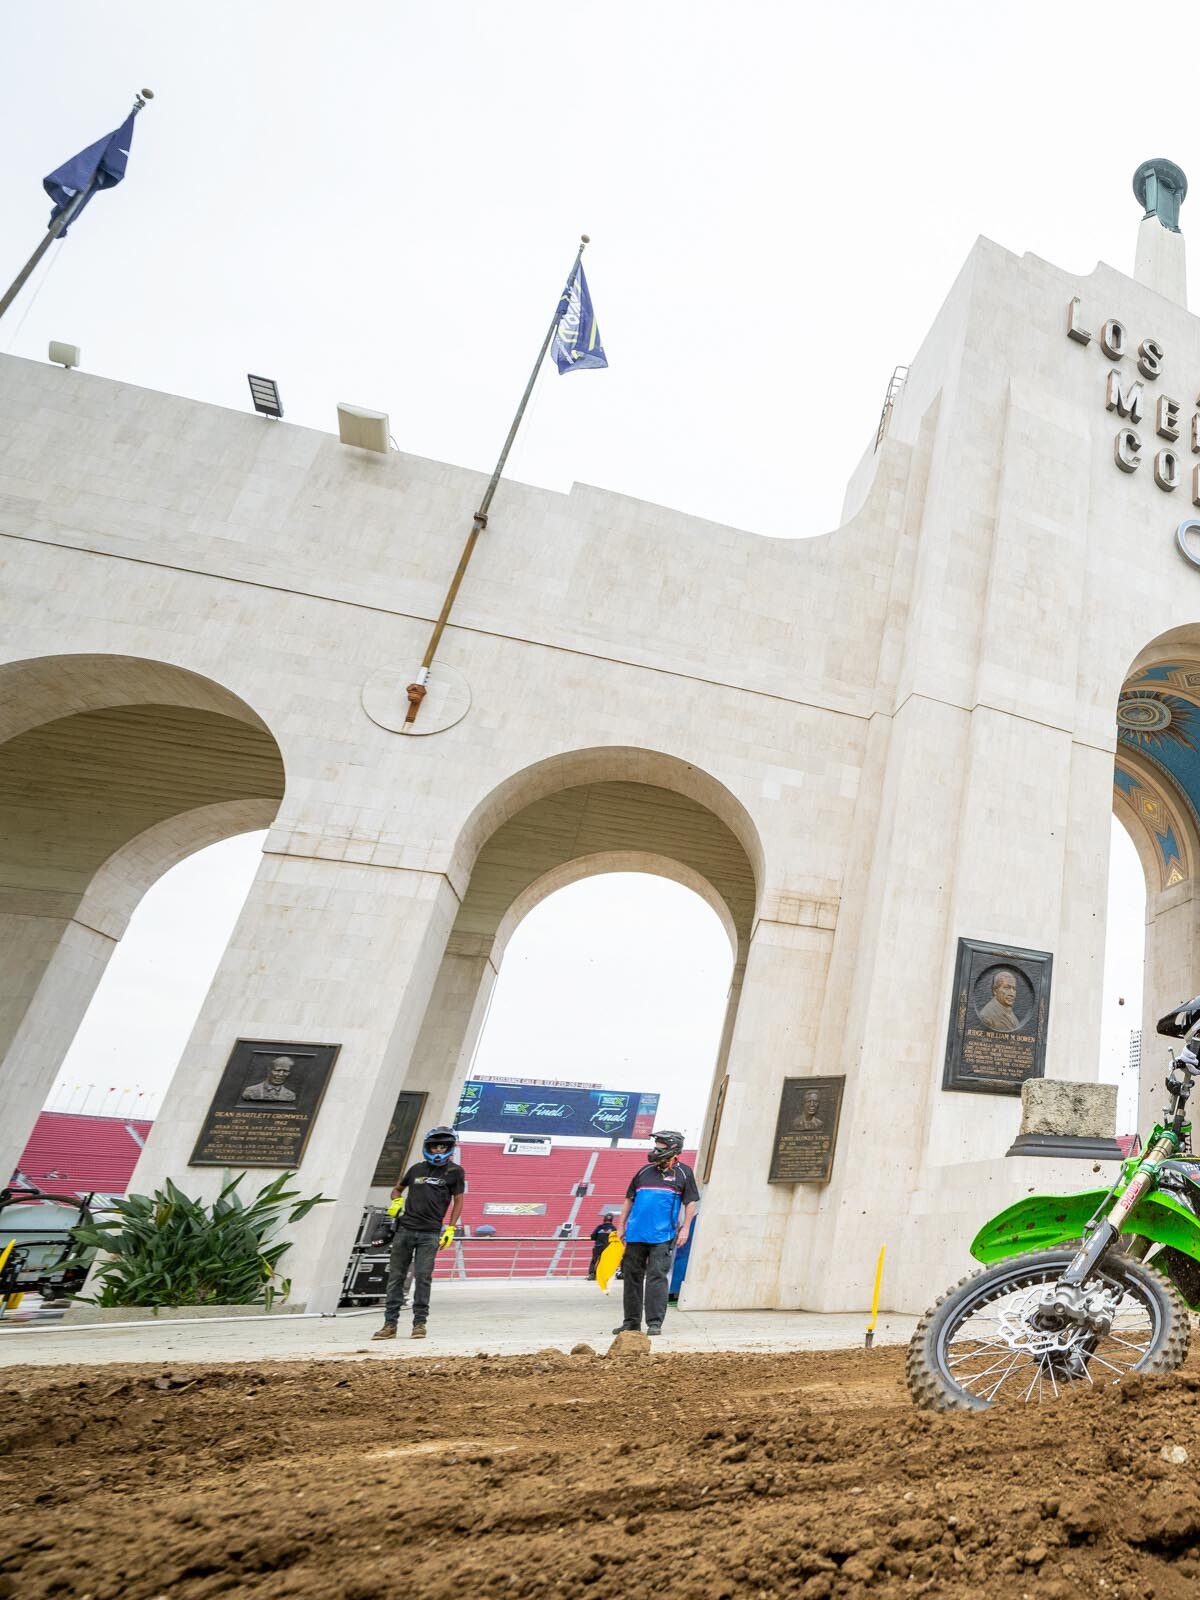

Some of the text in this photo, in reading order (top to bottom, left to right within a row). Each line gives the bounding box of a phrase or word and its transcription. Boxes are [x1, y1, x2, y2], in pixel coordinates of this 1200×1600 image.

[1066, 296, 1163, 380] LOS
[986, 1031, 1009, 1041] WILLIAM
[528, 1103, 565, 1117] Finals
[589, 1108, 628, 1122] Finals
[1120, 1180, 1143, 1211] SHOWA
